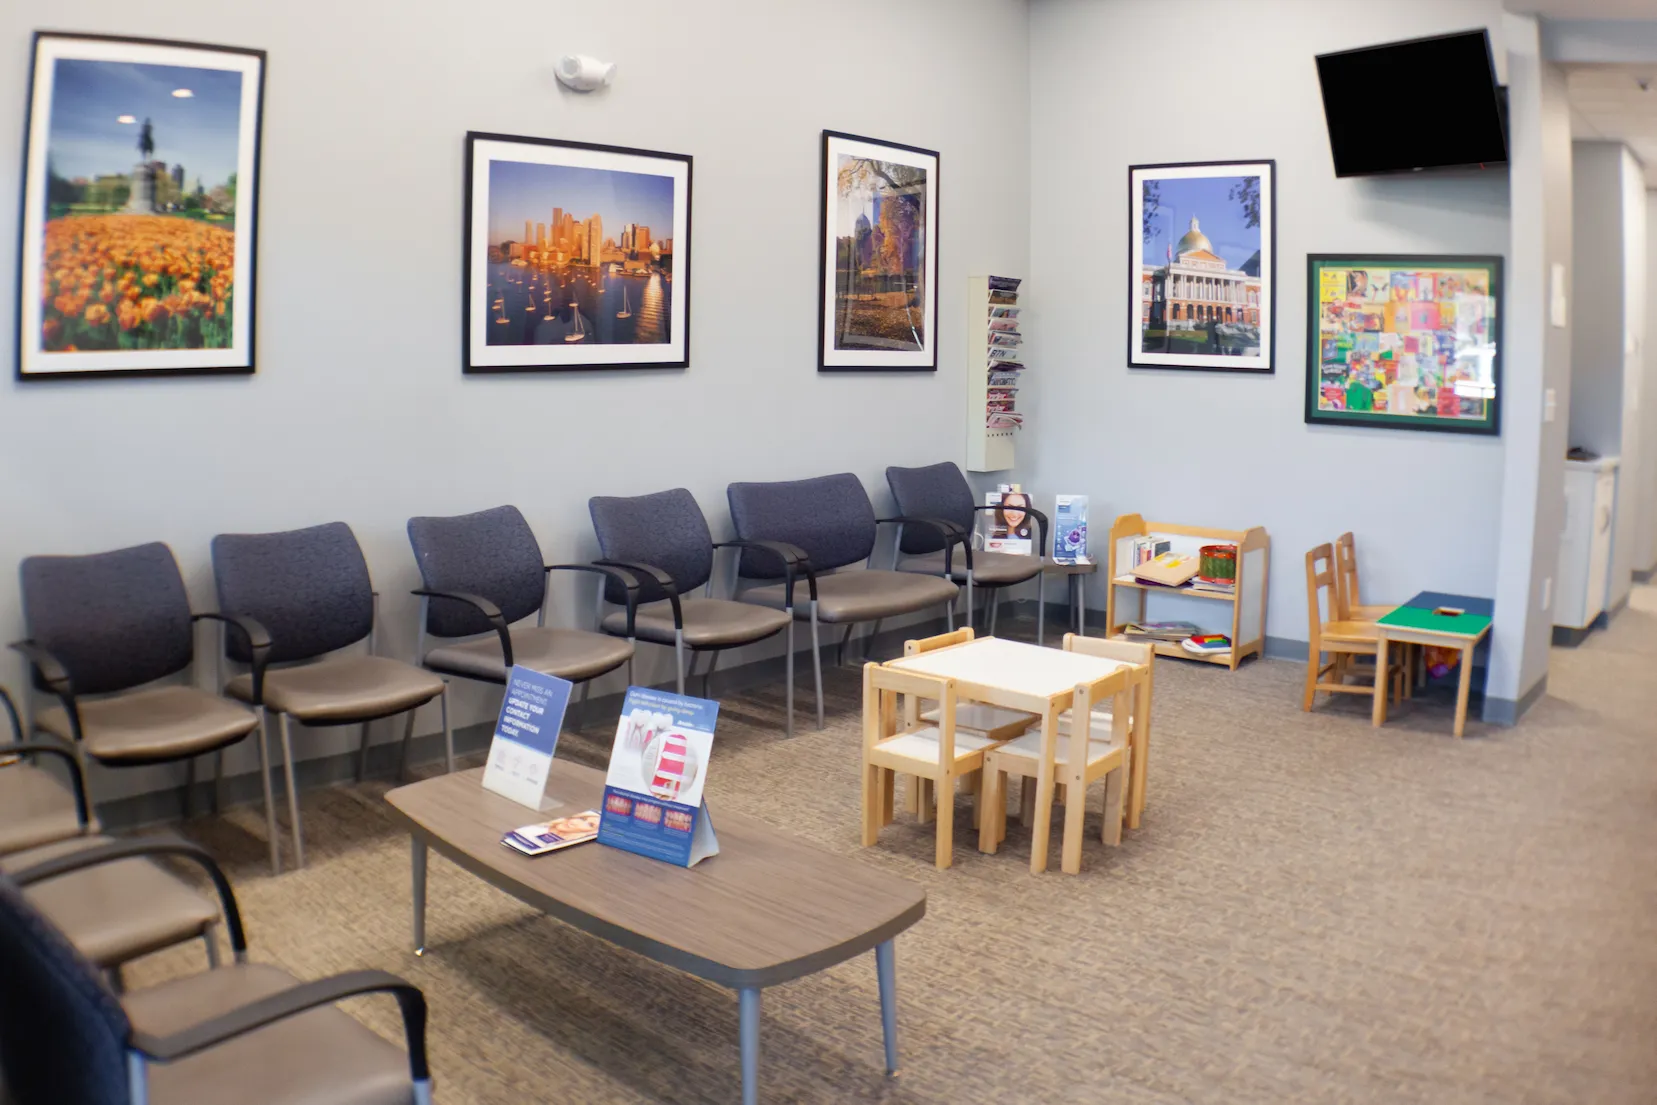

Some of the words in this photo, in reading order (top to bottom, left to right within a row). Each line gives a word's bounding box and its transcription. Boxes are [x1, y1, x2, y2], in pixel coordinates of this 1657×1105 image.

[506, 706, 531, 720] CONTACT
[508, 697, 529, 710] UPDATE
[529, 703, 545, 715] YOUR
[503, 715, 540, 735] INFORMATION
